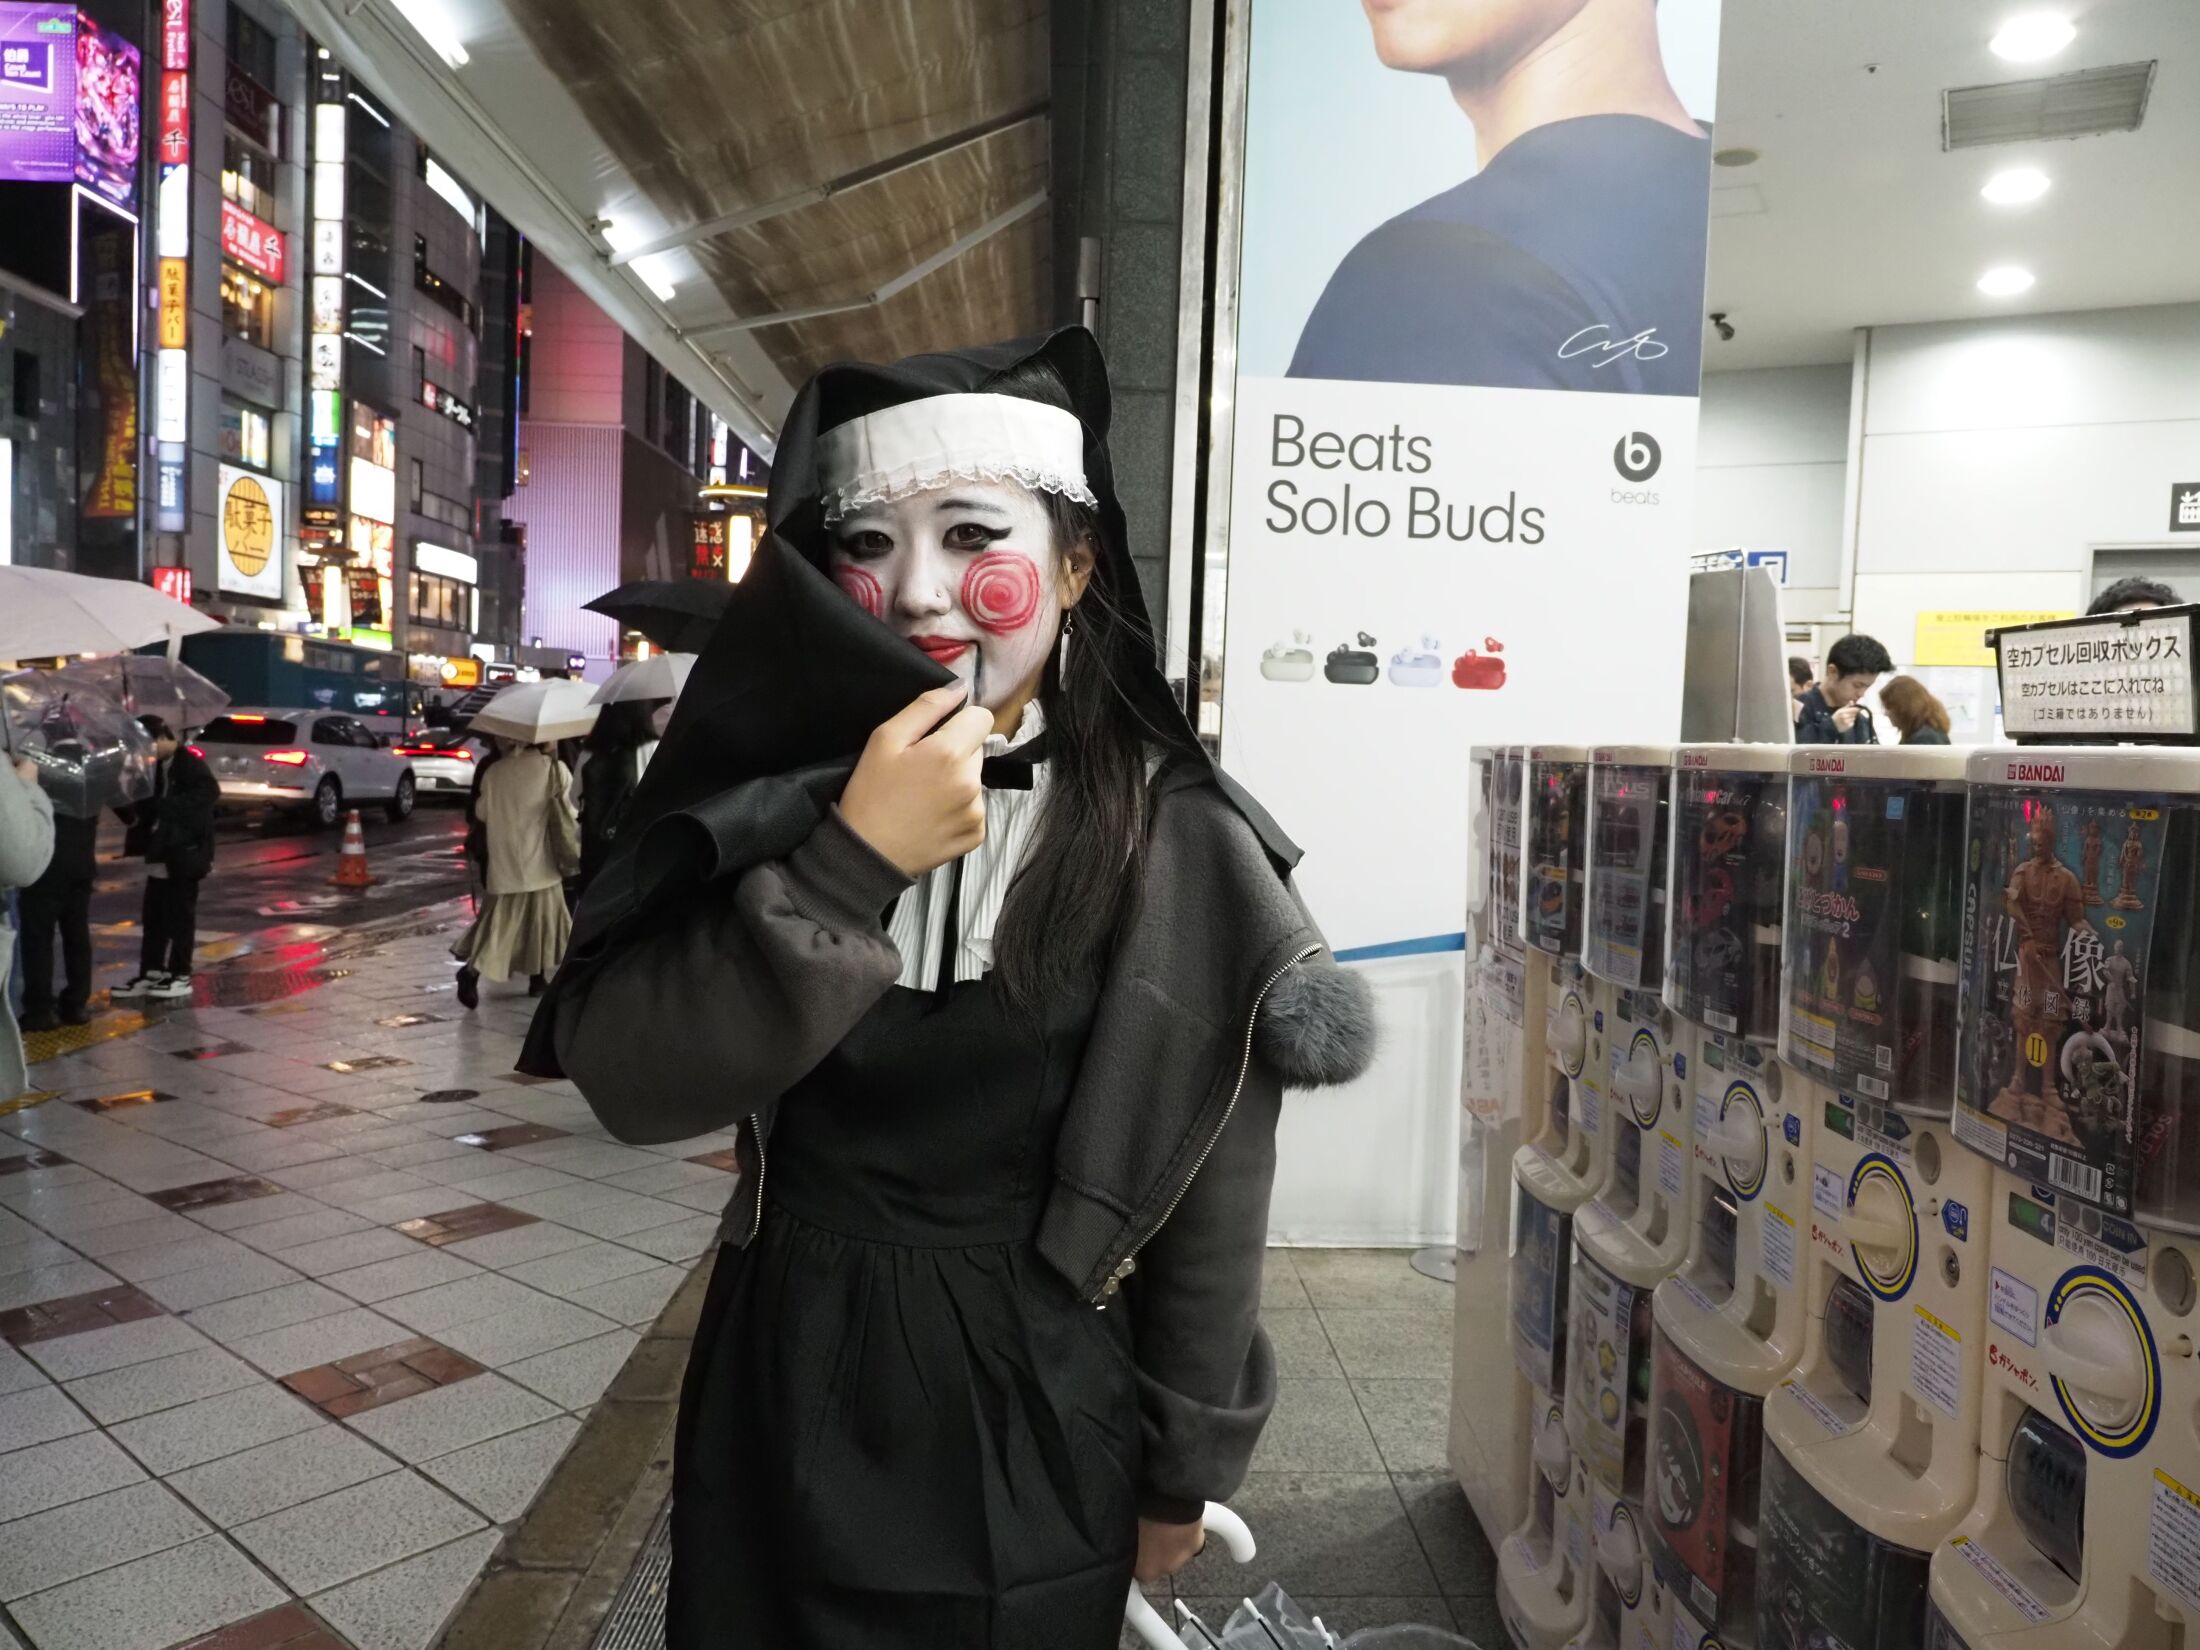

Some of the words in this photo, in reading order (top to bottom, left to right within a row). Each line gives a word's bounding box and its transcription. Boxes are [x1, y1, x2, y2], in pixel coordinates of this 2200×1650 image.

[1271, 413, 1433, 474] Beats
[1610, 488, 1661, 506] beats
[226, 499, 272, 538] 駄菓子
[1265, 479, 1391, 538] Solo
[1407, 486, 1546, 545] Buds
[2006, 635, 2182, 669] 空カプセル回収ボックス
[2021, 676, 2165, 698] 空カプセルはここに入れてね
[1816, 758, 1845, 772] BANDAI
[2018, 764, 2065, 782] BANDAI
[1992, 914, 2107, 993] 仏像
[2072, 1230, 2083, 1243] 100
[2102, 1220, 2125, 1239] COIN
[1998, 1352, 2040, 1392] ガシャポン
